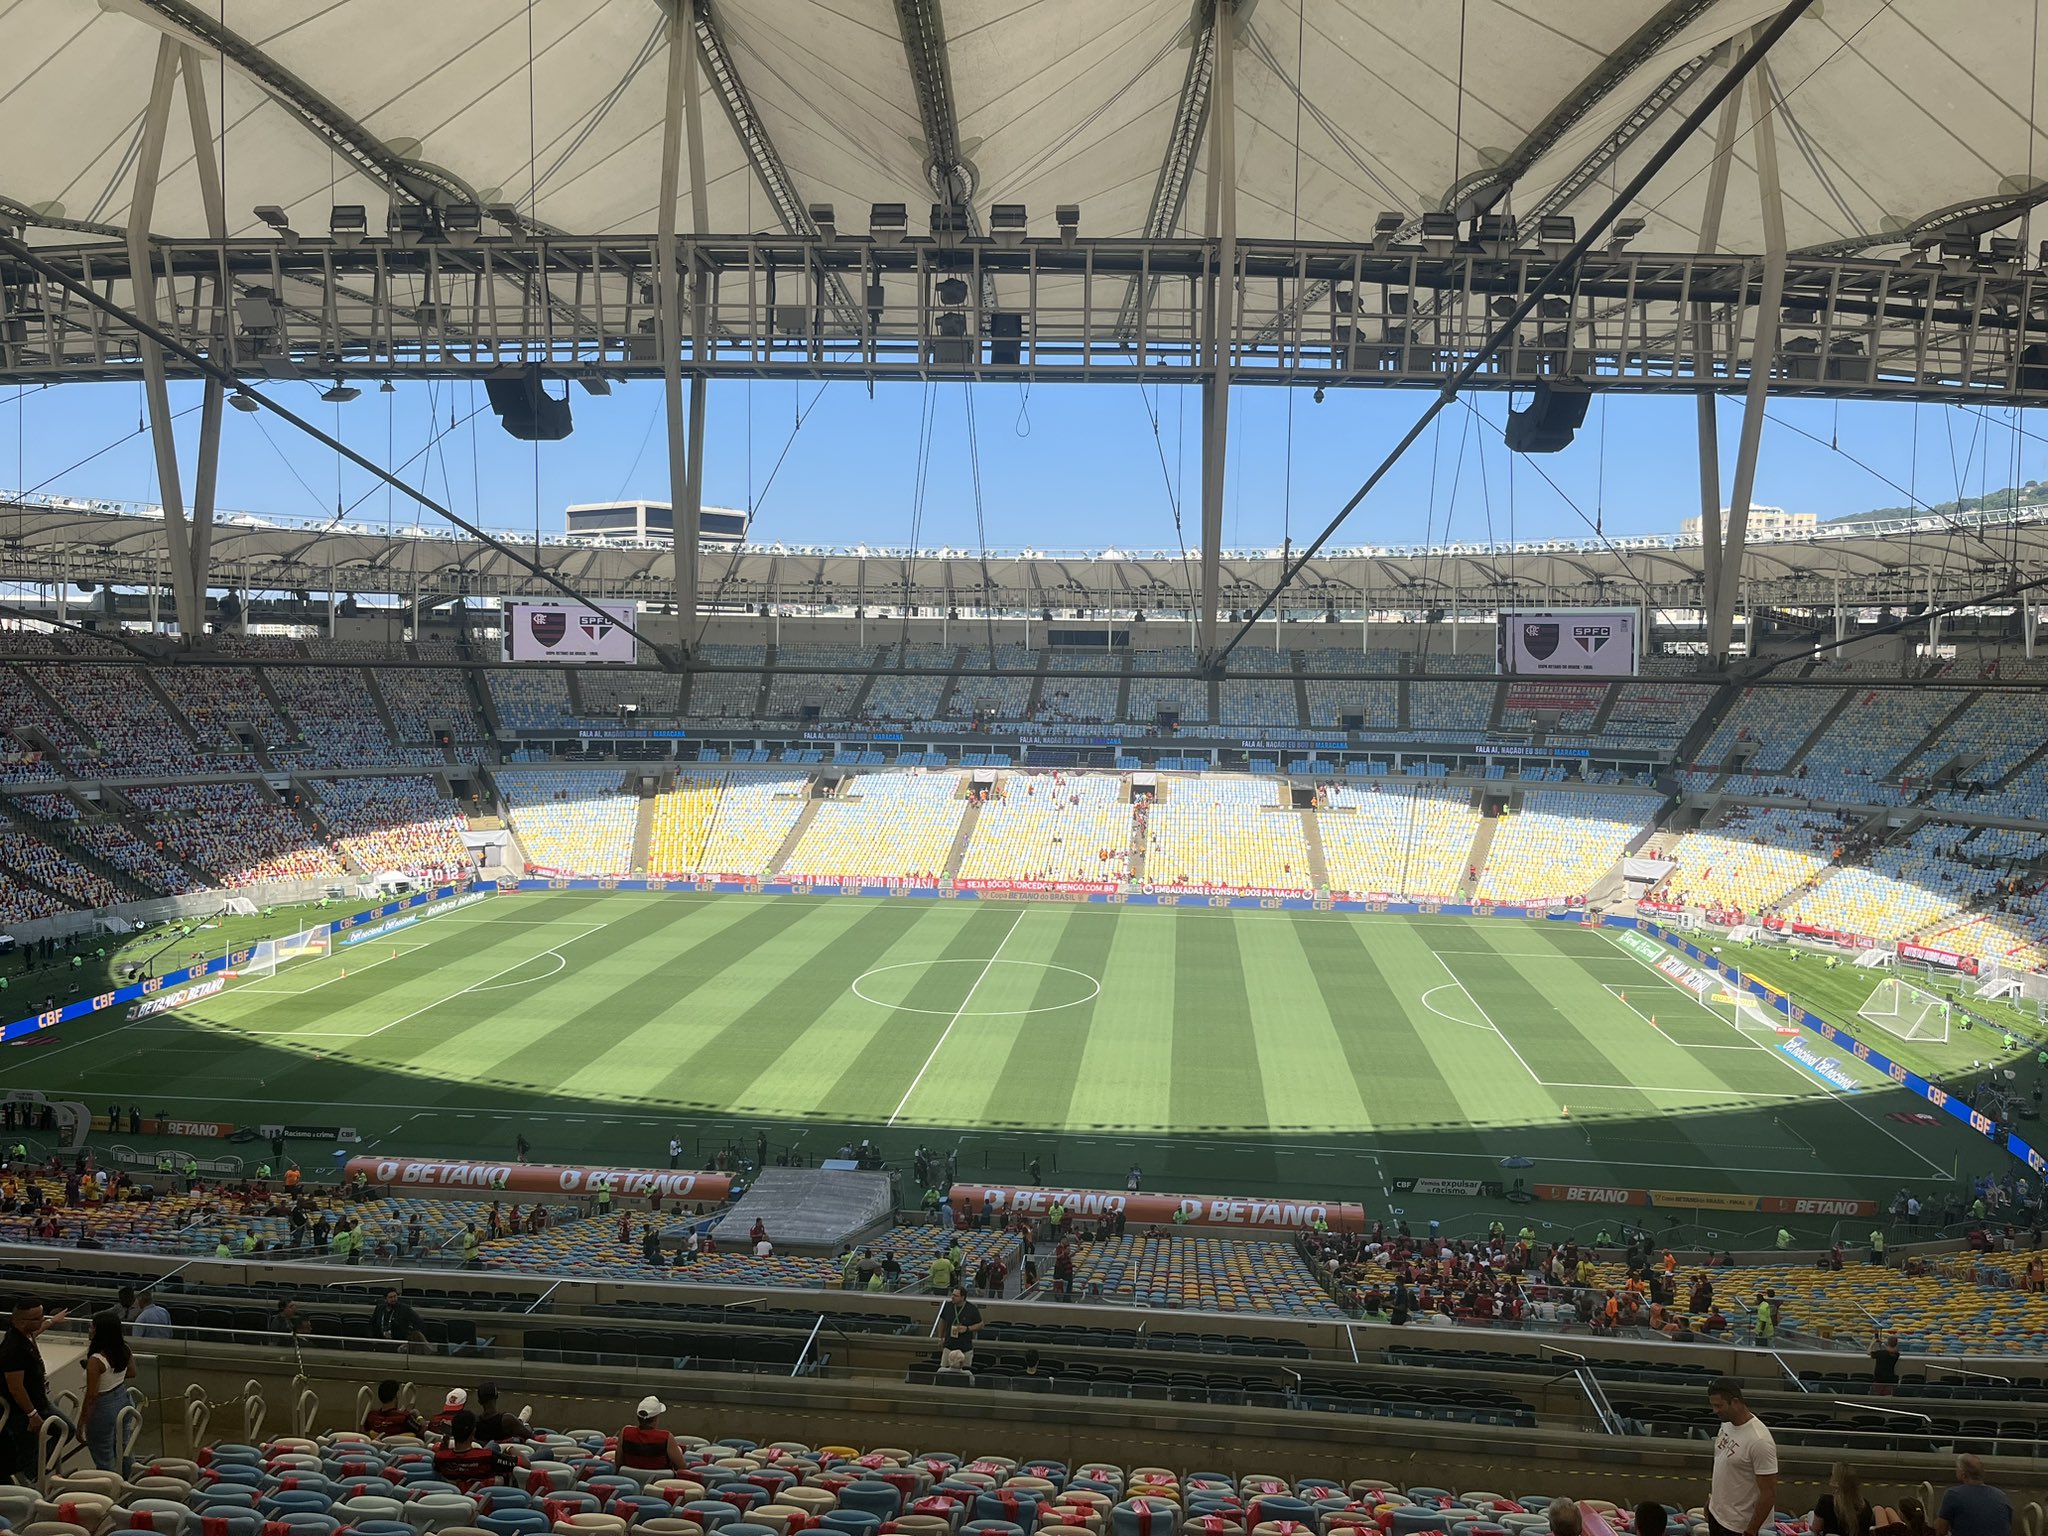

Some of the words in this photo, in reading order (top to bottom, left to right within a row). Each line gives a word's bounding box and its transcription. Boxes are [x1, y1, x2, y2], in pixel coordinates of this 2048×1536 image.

[804, 732, 817, 740] FALA
[548, 880, 571, 889] CBF
[598, 880, 619, 889] CBF
[647, 882, 667, 890] CBF
[695, 883, 716, 891] CBF
[743, 884, 764, 892] CBF
[792, 885, 814, 894] CBF
[841, 887, 863, 896] CBF
[890, 888, 911, 896] CBF
[939, 890, 960, 898] CBF
[816, 876, 840, 886] MAIS
[842, 876, 883, 887] QUERIDO
[1155, 886, 1204, 894] EMBAIXADAS
[1211, 888, 1260, 896] CONSULDOS
[1106, 894, 1129, 903] CBF
[1158, 896, 1180, 905] CBF
[1208, 897, 1231, 906] CBF
[1260, 899, 1283, 908] CBF
[1312, 901, 1335, 910] CBF
[1365, 903, 1388, 912] CBF
[1418, 904, 1441, 914] CBF
[1472, 906, 1495, 916] CBF
[340, 917, 354, 929] CBF
[370, 907, 384, 919] CBF
[38, 1008, 63, 1029] CBF
[92, 991, 116, 1010] CBF
[142, 976, 164, 994] CBF
[188, 963, 208, 978] CBF
[231, 950, 249, 965] CBF
[138, 992, 180, 1017] BETANO
[188, 978, 225, 1000] BETANO
[1791, 1005, 1806, 1022] CBF
[1820, 1022, 1836, 1040] CBF
[1853, 1041, 1870, 1060] CBF
[1888, 1062, 1907, 1083] CBF
[1927, 1085, 1948, 1107] CBF
[1970, 1110, 1992, 1135] CBF
[2028, 1148, 2045, 1175] CBF
[168, 1122, 218, 1136] BETANO
[402, 1163, 512, 1185] BETANO
[585, 1171, 696, 1196] BETANO
[1011, 1191, 1126, 1215] BETANO
[1567, 1188, 1629, 1203] BETANO
[1208, 1200, 1327, 1227] BETANO
[1795, 1200, 1858, 1215] BETANO
